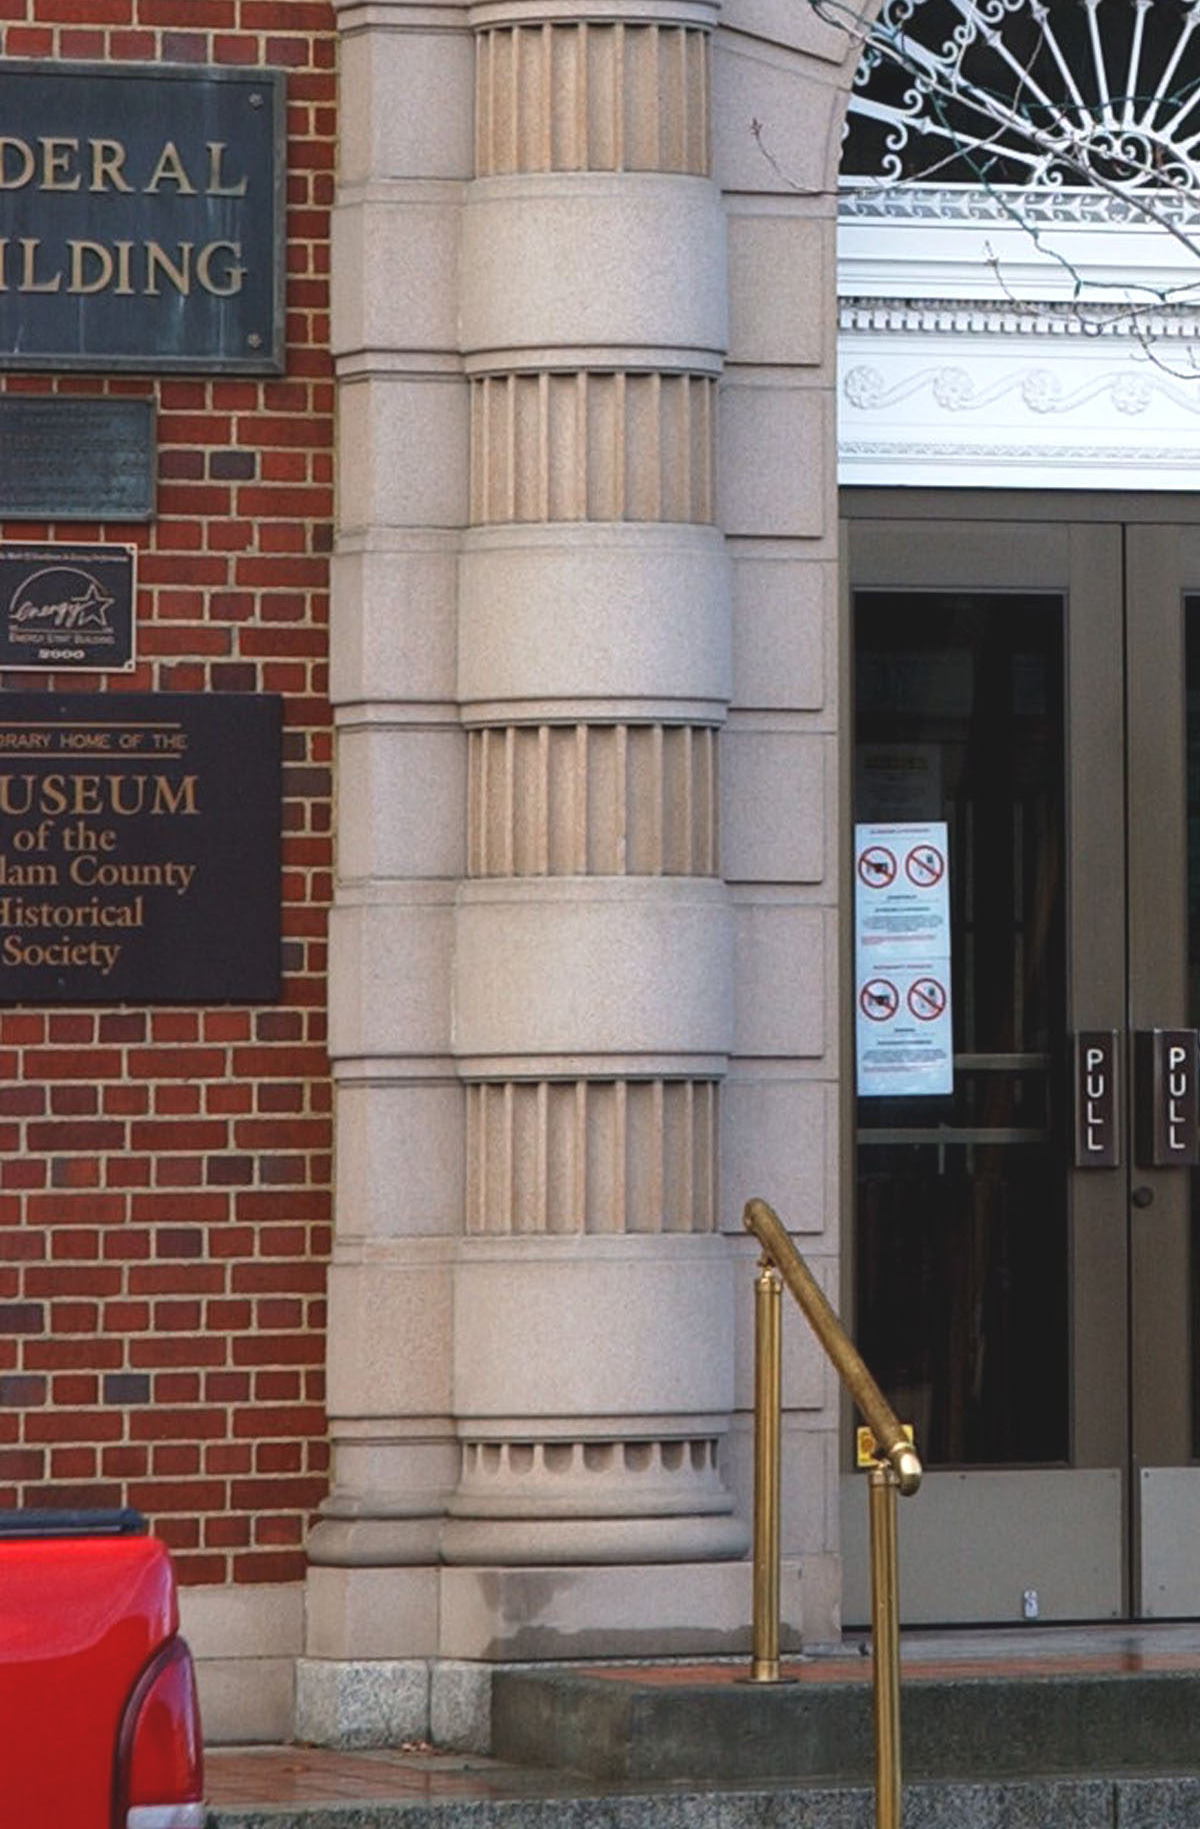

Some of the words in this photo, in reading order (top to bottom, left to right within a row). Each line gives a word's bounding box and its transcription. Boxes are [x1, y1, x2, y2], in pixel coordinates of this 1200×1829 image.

[60, 733, 112, 749] HOME
[119, 733, 145, 749] OF
[152, 734, 188, 749] THE
[0, 774, 200, 816] USEUM
[13, 820, 56, 852] of
[62, 821, 118, 852] the
[70, 855, 197, 895] County
[3, 934, 122, 975] Society
[1086, 1048, 1105, 1151] PULL
[1169, 1046, 1187, 1150] PULL
